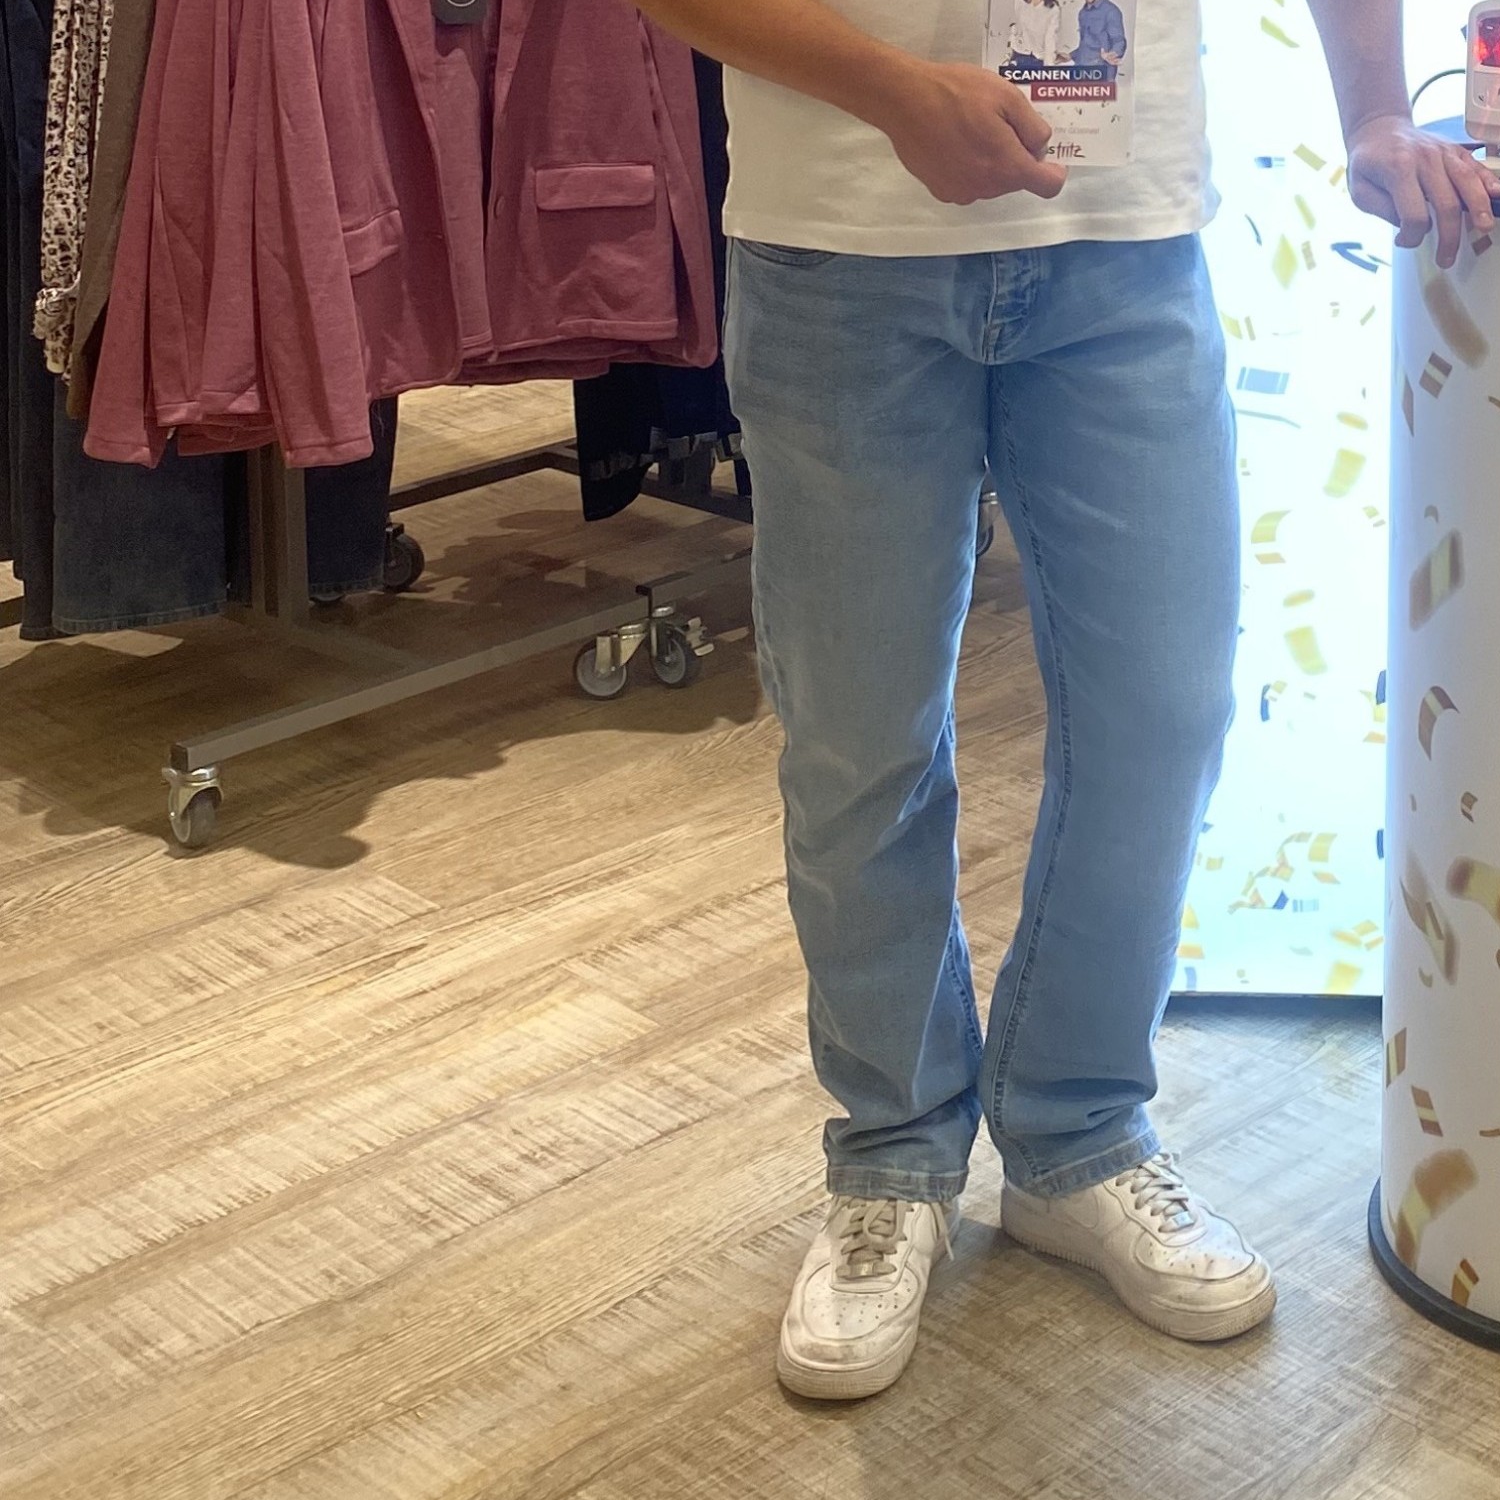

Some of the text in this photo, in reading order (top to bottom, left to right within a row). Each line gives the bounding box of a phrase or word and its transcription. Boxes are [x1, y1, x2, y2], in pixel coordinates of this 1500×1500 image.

[1004, 64, 1102, 81] SCANNEN UND
[1037, 85, 1111, 98] GEWINNEN
